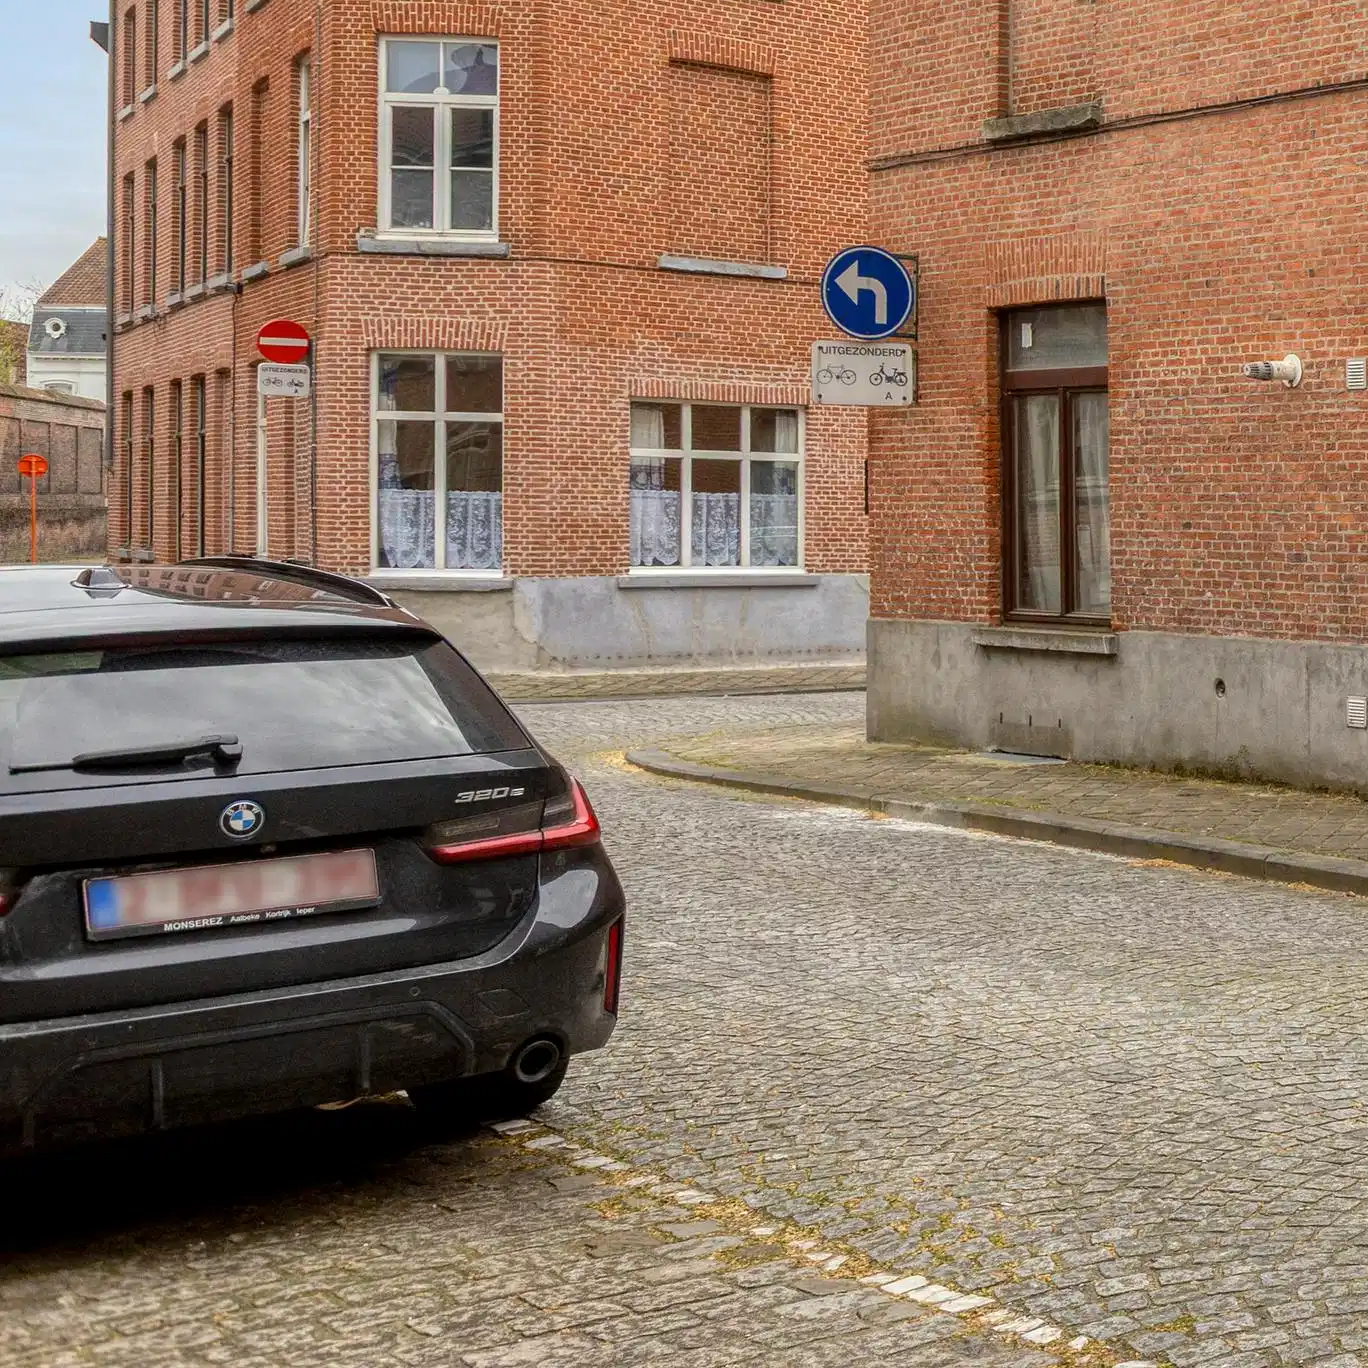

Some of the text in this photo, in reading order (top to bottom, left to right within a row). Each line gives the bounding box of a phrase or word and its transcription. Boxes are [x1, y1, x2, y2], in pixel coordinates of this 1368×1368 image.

[821, 345, 903, 357] UITGEZONDERD
[885, 392, 893, 400] A
[163, 916, 223, 931] MONSEREZ
